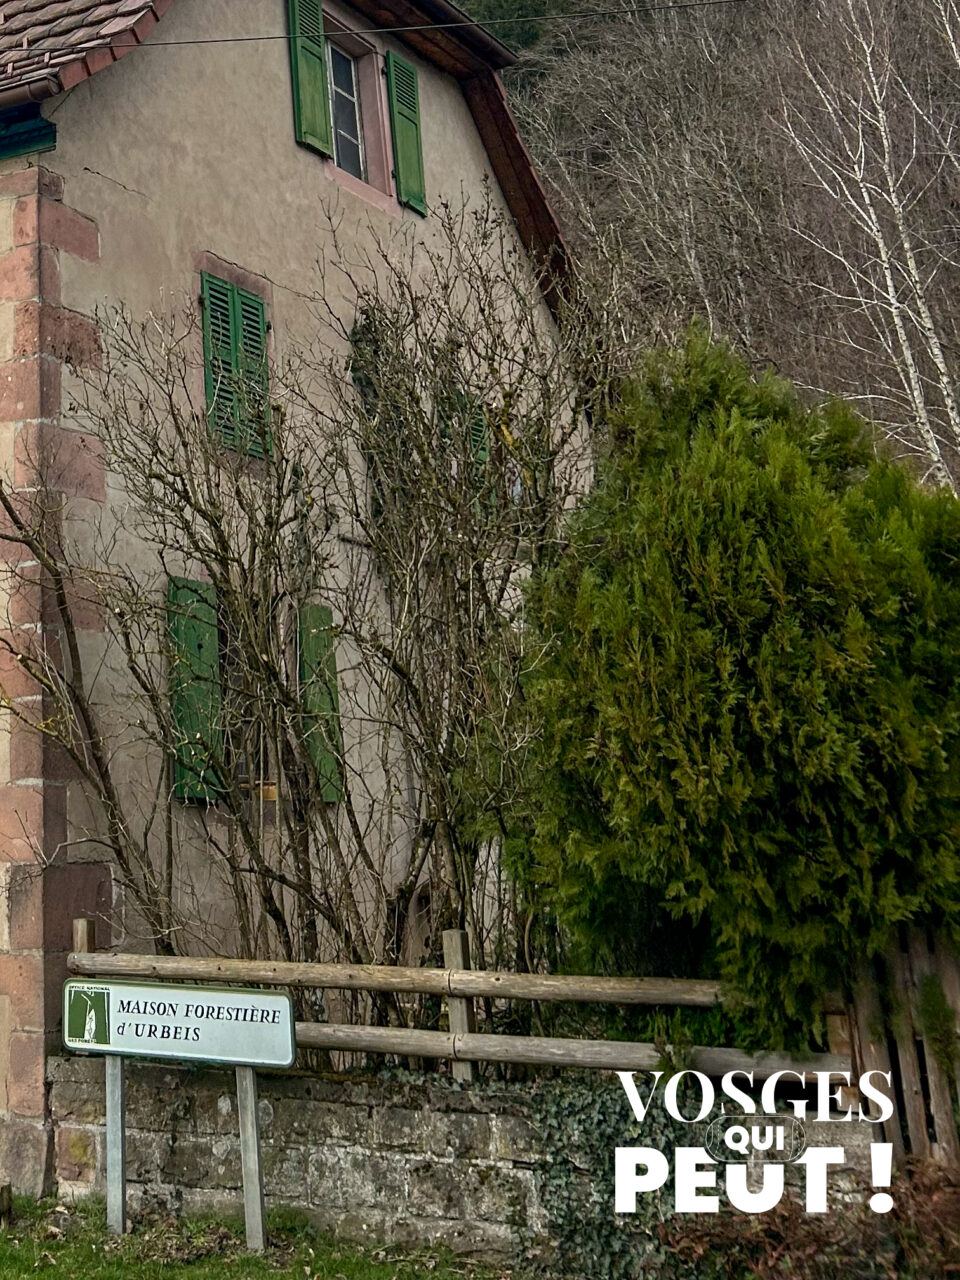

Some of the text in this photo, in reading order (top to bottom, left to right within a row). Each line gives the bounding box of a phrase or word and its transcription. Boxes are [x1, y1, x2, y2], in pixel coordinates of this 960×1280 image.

[117, 999, 280, 1024] MAISON FORESTIÈRE
[117, 1022, 201, 1042] d'URBEIS
